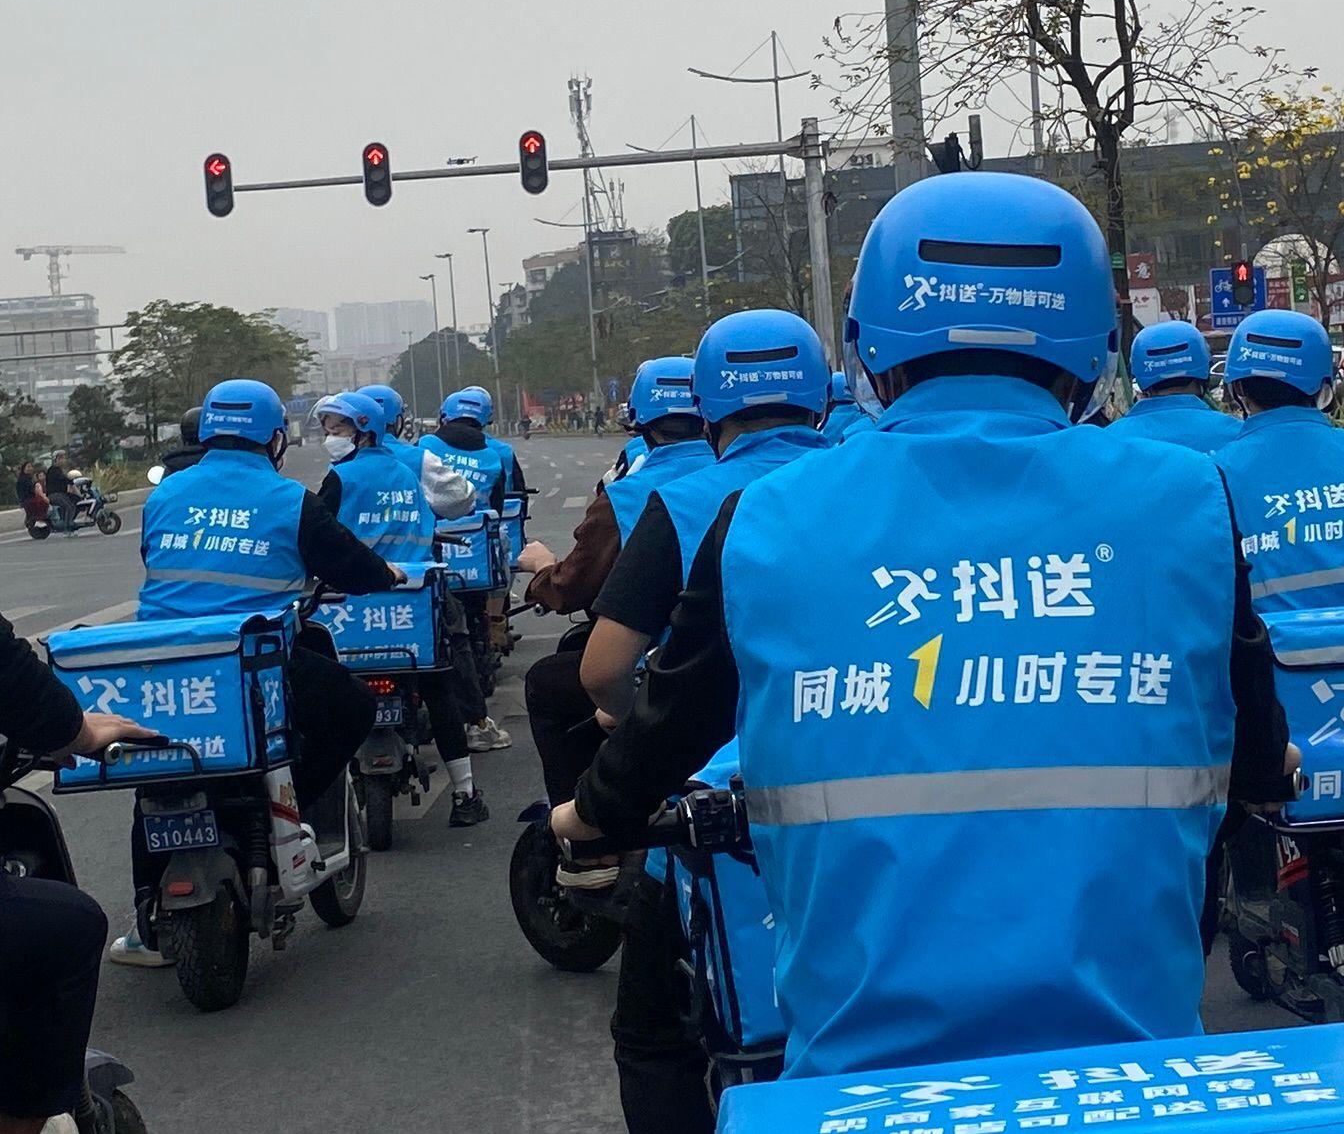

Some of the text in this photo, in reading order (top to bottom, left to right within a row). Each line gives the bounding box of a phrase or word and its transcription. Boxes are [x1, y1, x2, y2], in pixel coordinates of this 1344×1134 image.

[160, 527, 270, 557] 同城1小时专送
[363, 604, 414, 631] 抖送
[793, 633, 1173, 723] 同城1小时专送
[150, 827, 216, 848] S10443
